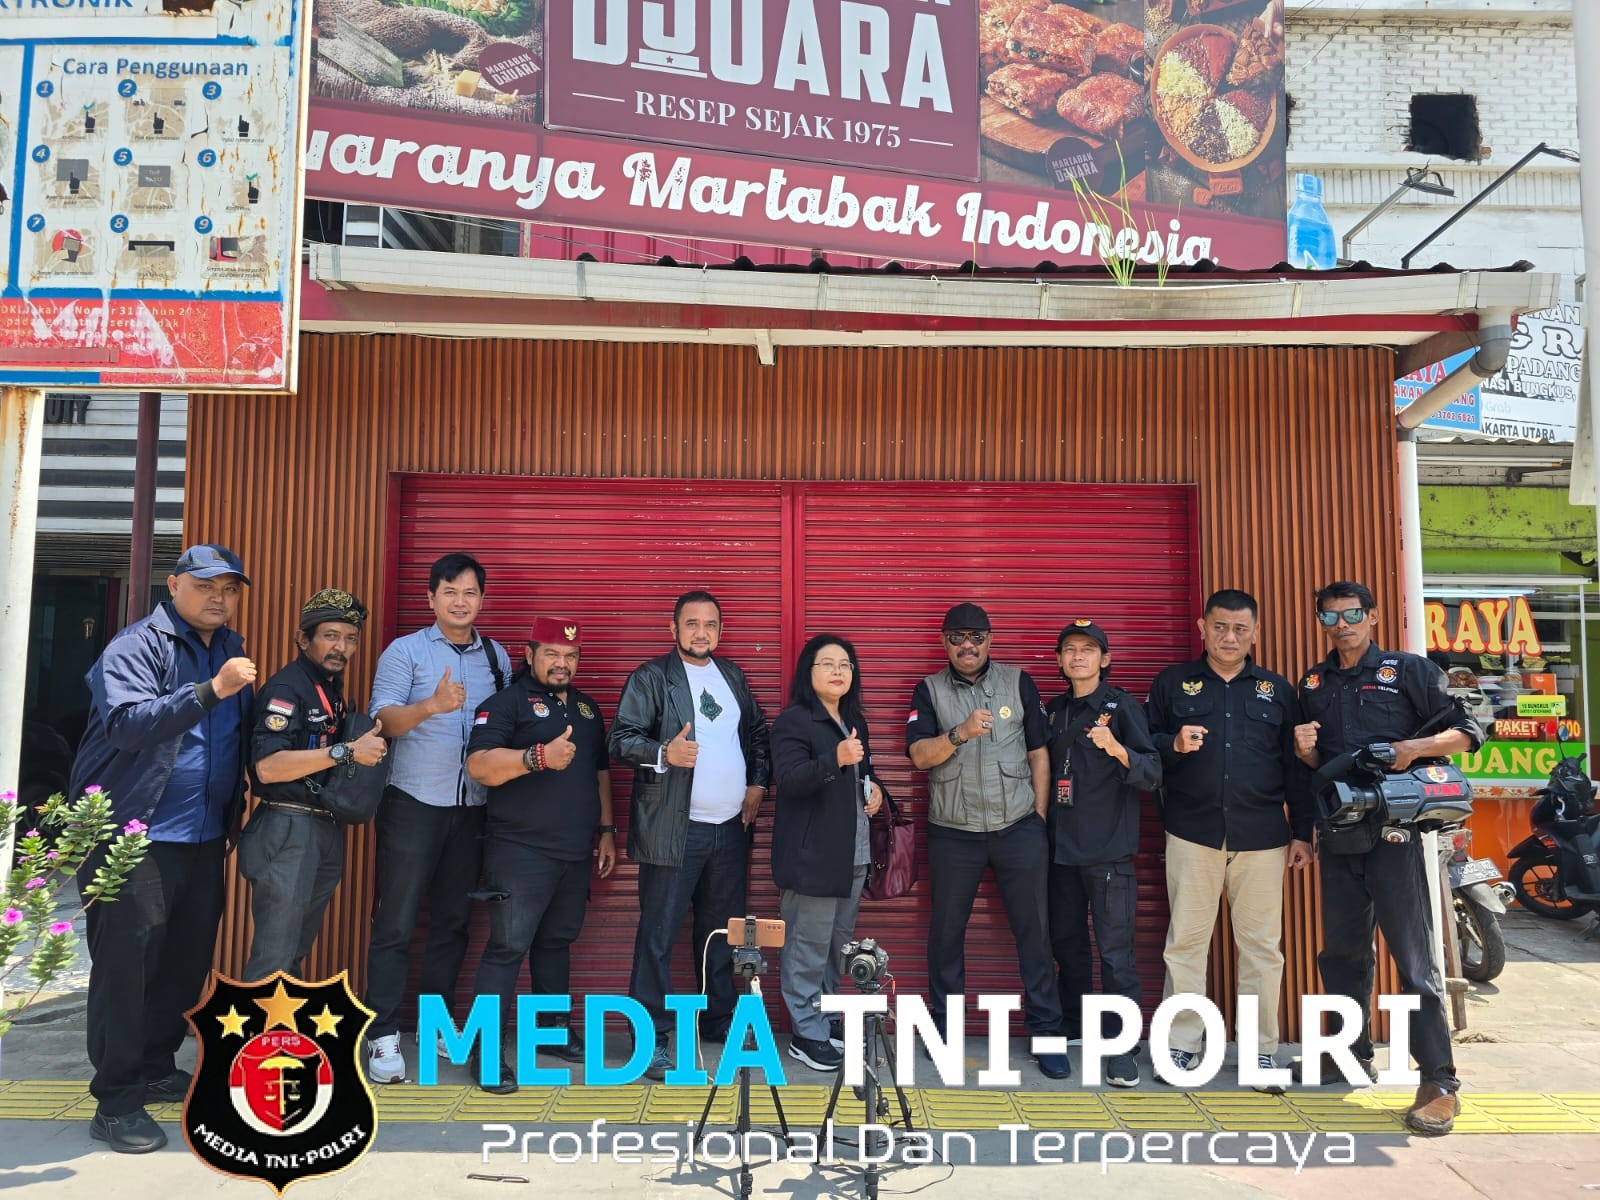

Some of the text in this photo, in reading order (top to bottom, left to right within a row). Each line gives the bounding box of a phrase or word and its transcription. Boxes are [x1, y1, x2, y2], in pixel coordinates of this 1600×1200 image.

[63, 58, 109, 76] Cara
[116, 58, 249, 79] Penggunaan
[485, 53, 531, 74] MARTABAK
[491, 61, 541, 85] DJUARA
[634, 91, 901, 148] RESEP SEJAK 1975
[1051, 152, 1094, 169] MARTABAK
[622, 151, 940, 238] Martabak
[1482, 377, 1510, 391] NASI
[1522, 426, 1556, 440] UTARA
[1424, 596, 1542, 656] RAYA
[1495, 720, 1538, 733] PAKET
[1450, 747, 1559, 775] DANG
